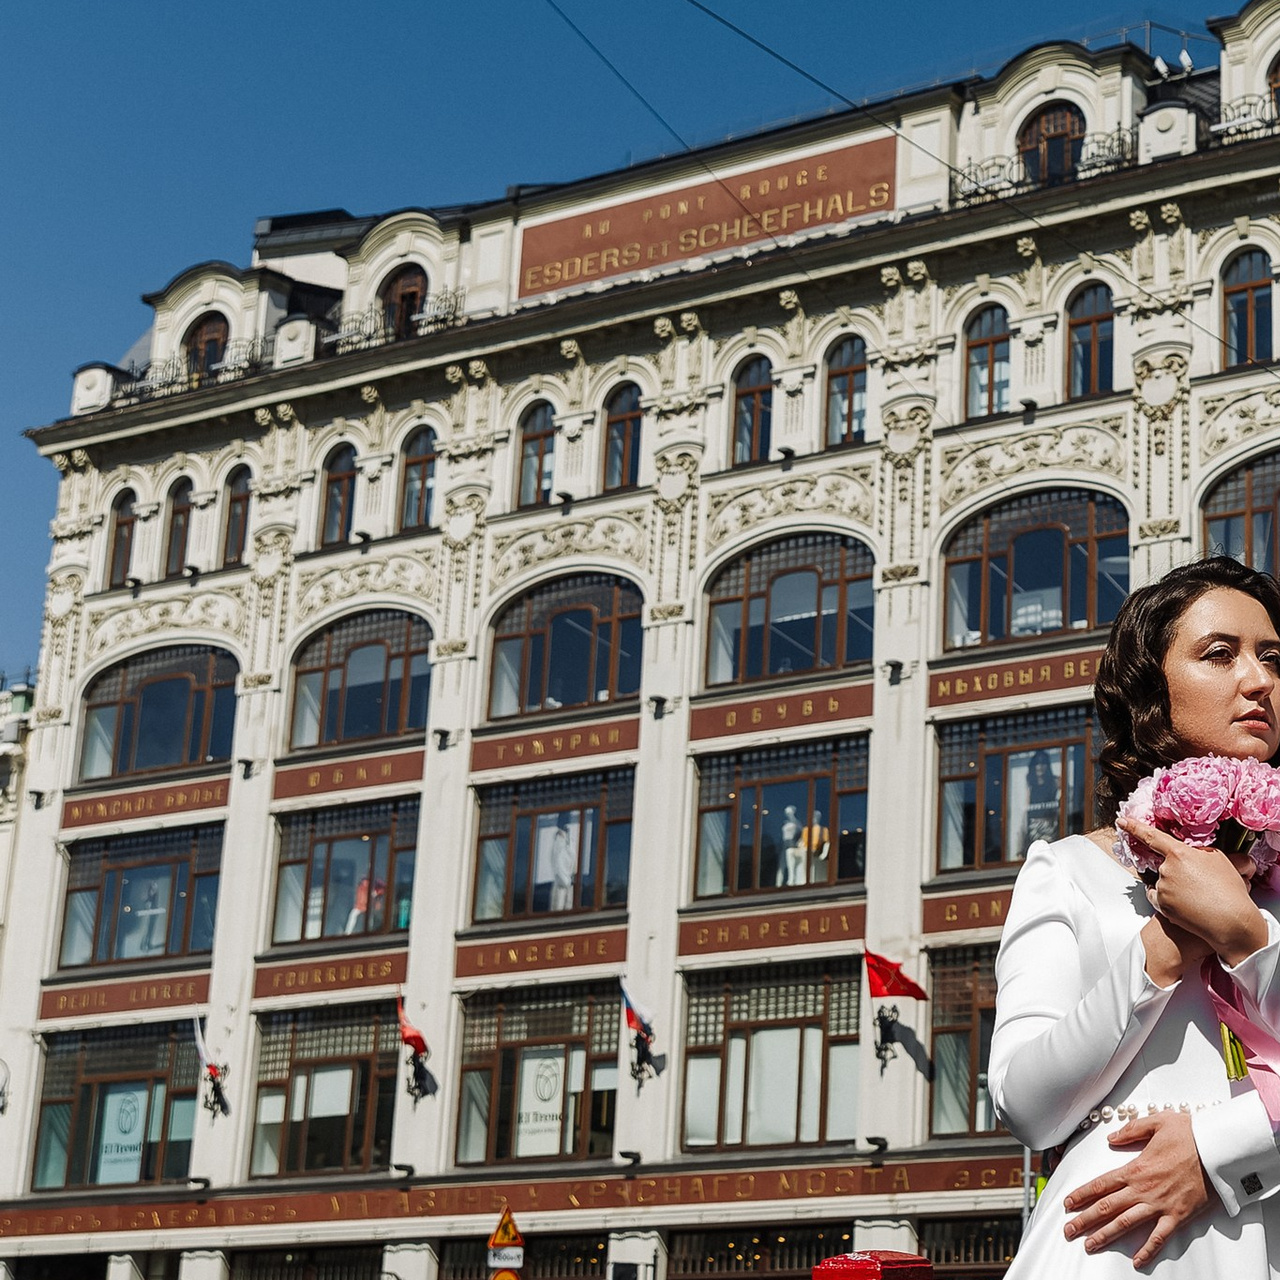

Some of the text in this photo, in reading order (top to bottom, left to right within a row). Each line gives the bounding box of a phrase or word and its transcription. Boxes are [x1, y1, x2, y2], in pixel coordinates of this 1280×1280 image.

[582, 165, 828, 239] AU PONT ROUGE
[525, 182, 890, 290] ESDERS ET SCHEEFHALS
[725, 696, 840, 728] ОБУВЬ
[696, 914, 850, 946] CHAPEAUX
[476, 938, 608, 968] LINGERIE
[272, 960, 392, 988] FOURRURES
[779, 1166, 911, 1196] МОСТА
[953, 1166, 1024, 1190] ЭСД
